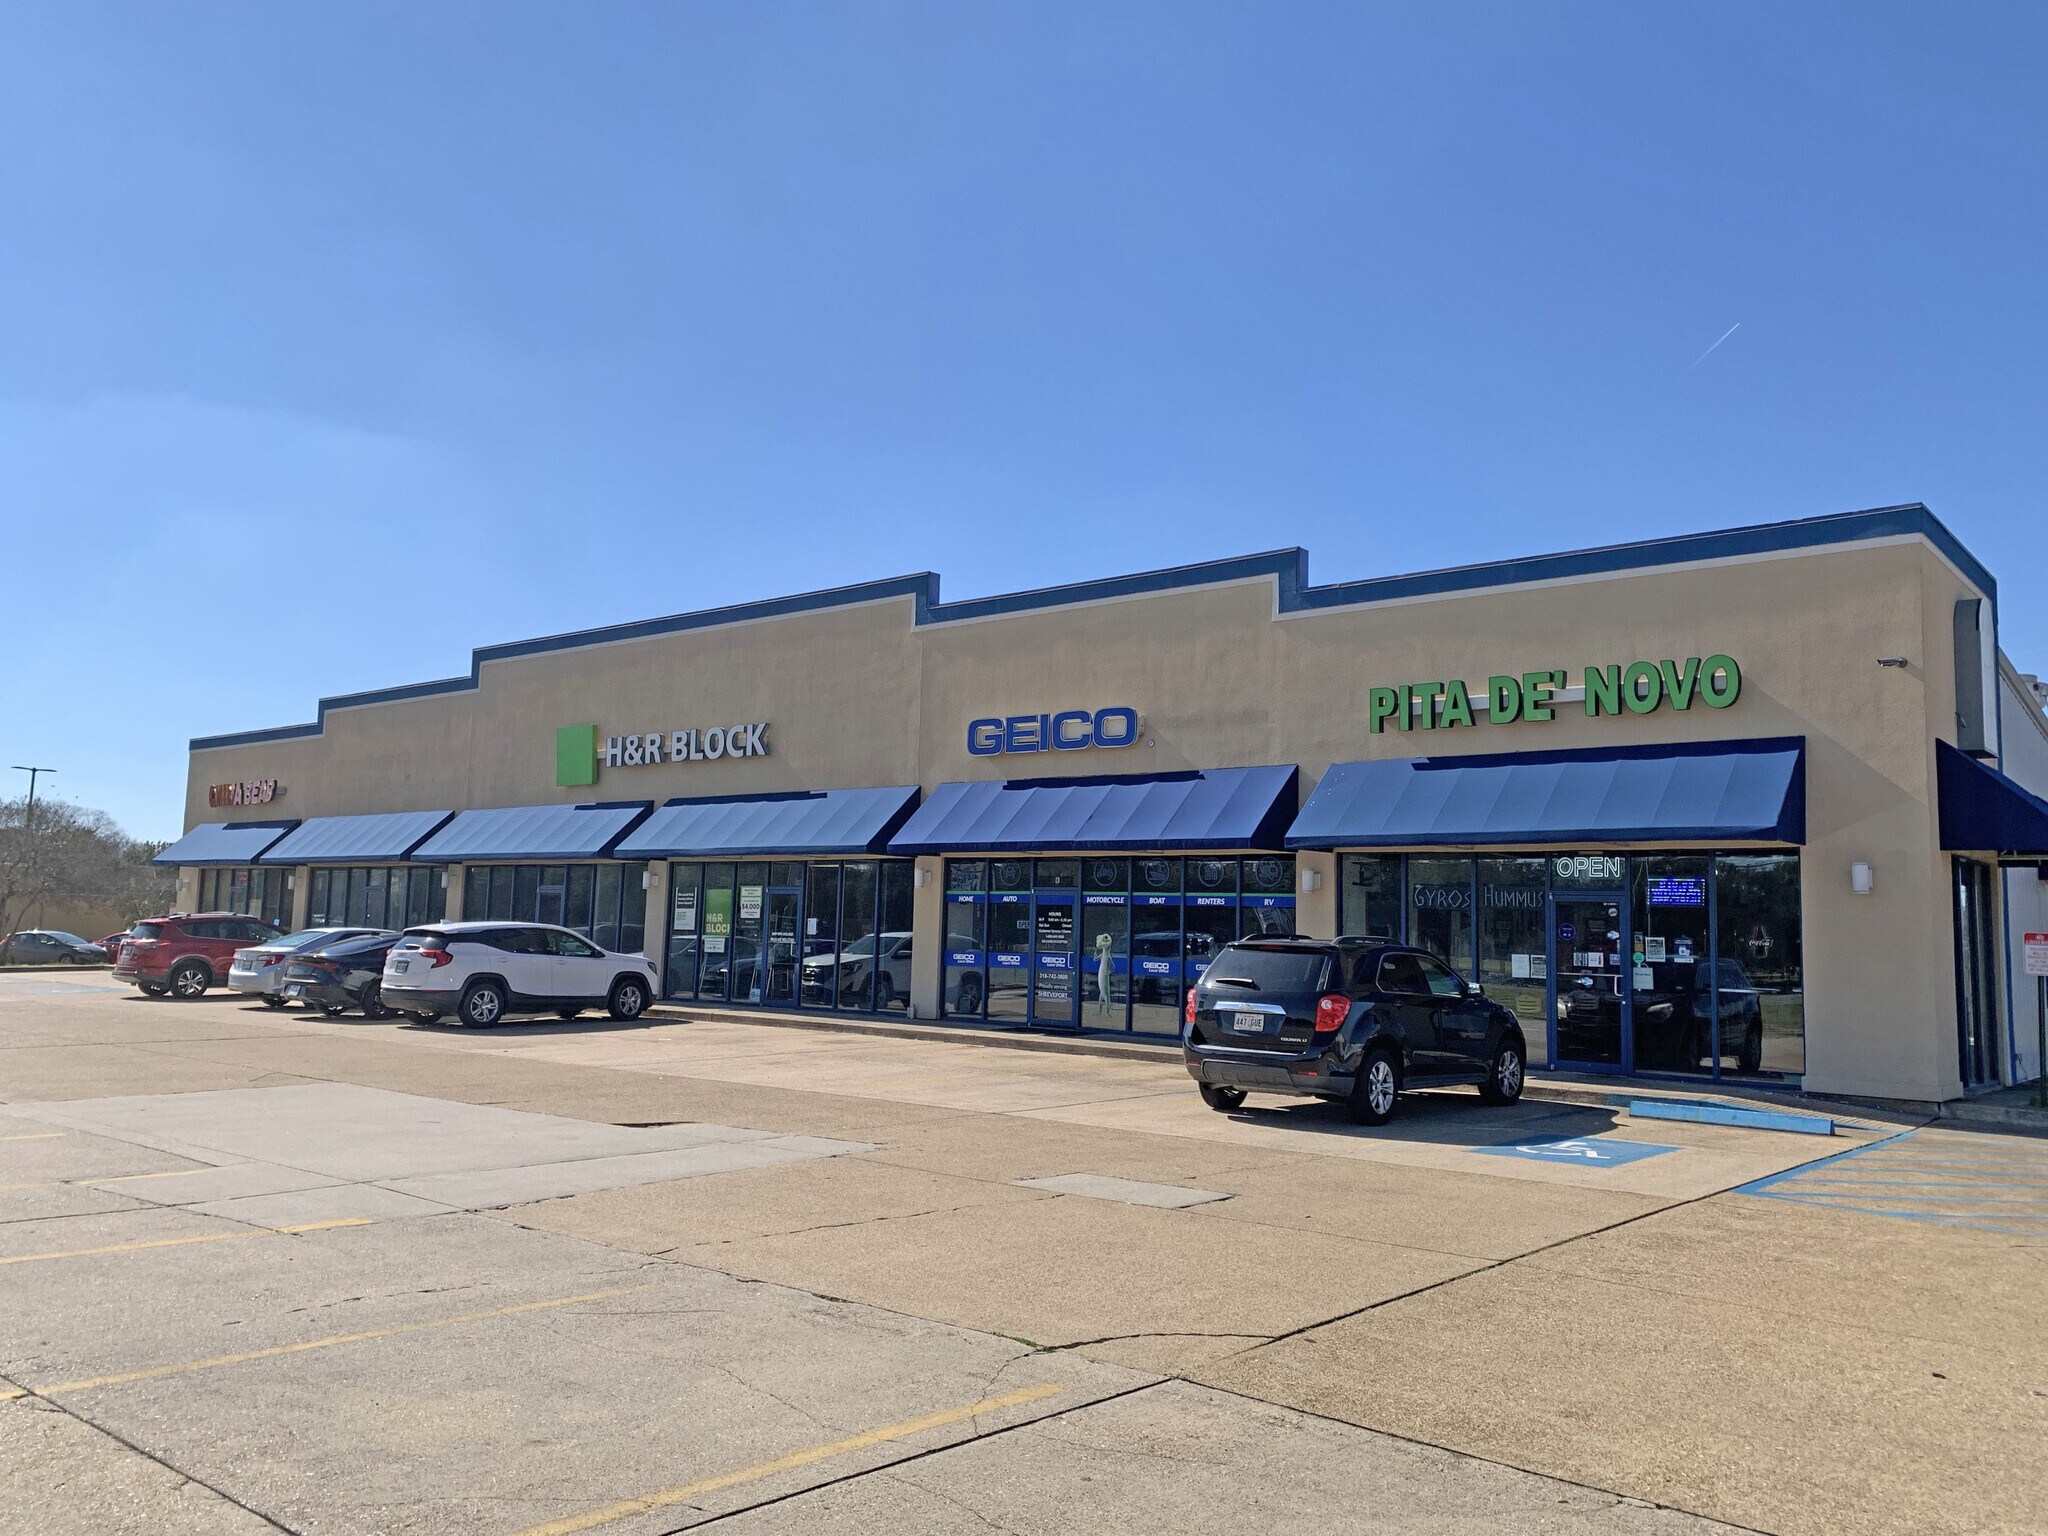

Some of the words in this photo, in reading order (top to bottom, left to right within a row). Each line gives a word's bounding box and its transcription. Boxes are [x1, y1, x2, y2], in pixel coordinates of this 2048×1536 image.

[1370, 680, 1474, 733] PITA
[1489, 670, 1567, 724] DE'
[1585, 654, 1741, 716] NOVO
[967, 706, 1139, 757] GEICO
[606, 732, 664, 768] H&R
[671, 722, 770, 762] BLOCK
[1556, 857, 1620, 878] OPEN
[1086, 896, 1125, 904] MOTORCYCLE
[1264, 898, 1275, 906] RV
[1415, 885, 1471, 908] GYROS
[1484, 885, 1544, 908] HUMMUS
[706, 913, 724, 923] H&R
